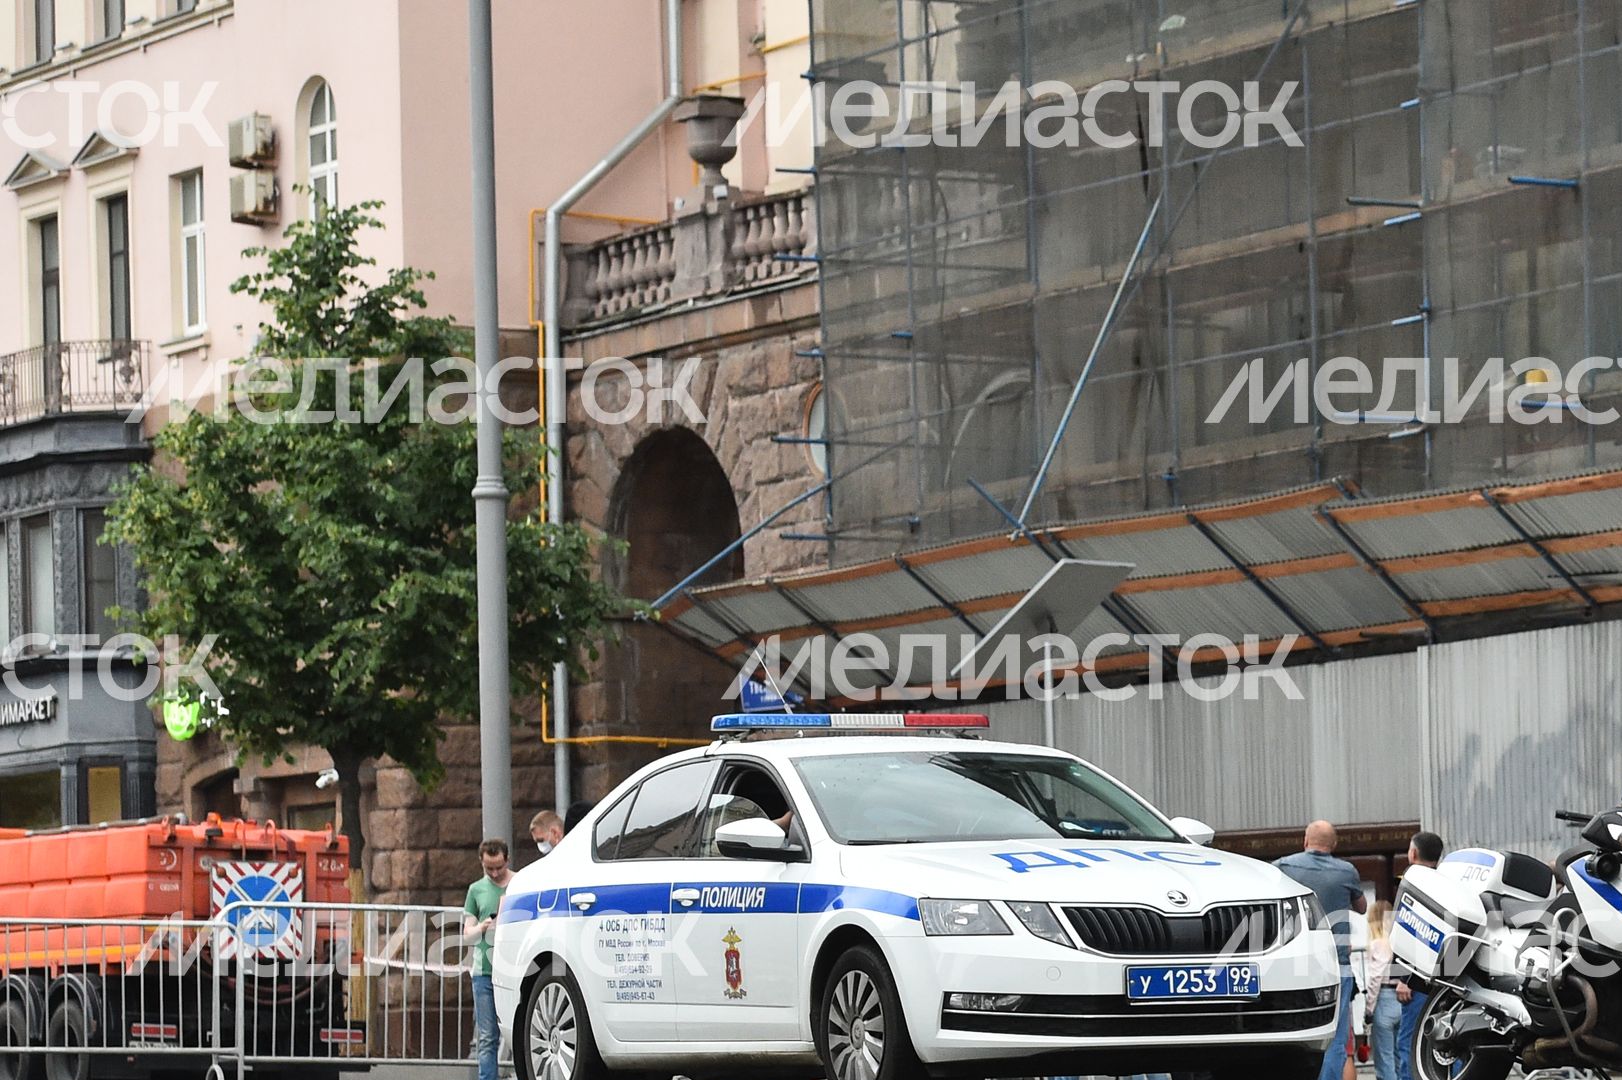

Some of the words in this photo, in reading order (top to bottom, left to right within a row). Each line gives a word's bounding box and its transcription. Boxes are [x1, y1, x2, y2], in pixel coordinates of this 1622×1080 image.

[991, 848, 1222, 873] ДПС
[1460, 865, 1490, 882] ДПС
[700, 887, 766, 911] ПОЛИЦИЯ
[623, 919, 639, 934] ДПС
[640, 917, 666, 933] ГИБДД
[1398, 906, 1440, 945] ПОЛИЦИЯ
[618, 978, 645, 989] ДЕЖУРНОЙ
[646, 979, 663, 989] ЧАСТИ
[1162, 968, 1217, 994] 1253
[1229, 966, 1251, 985] 99
[1233, 985, 1249, 993] RUS
